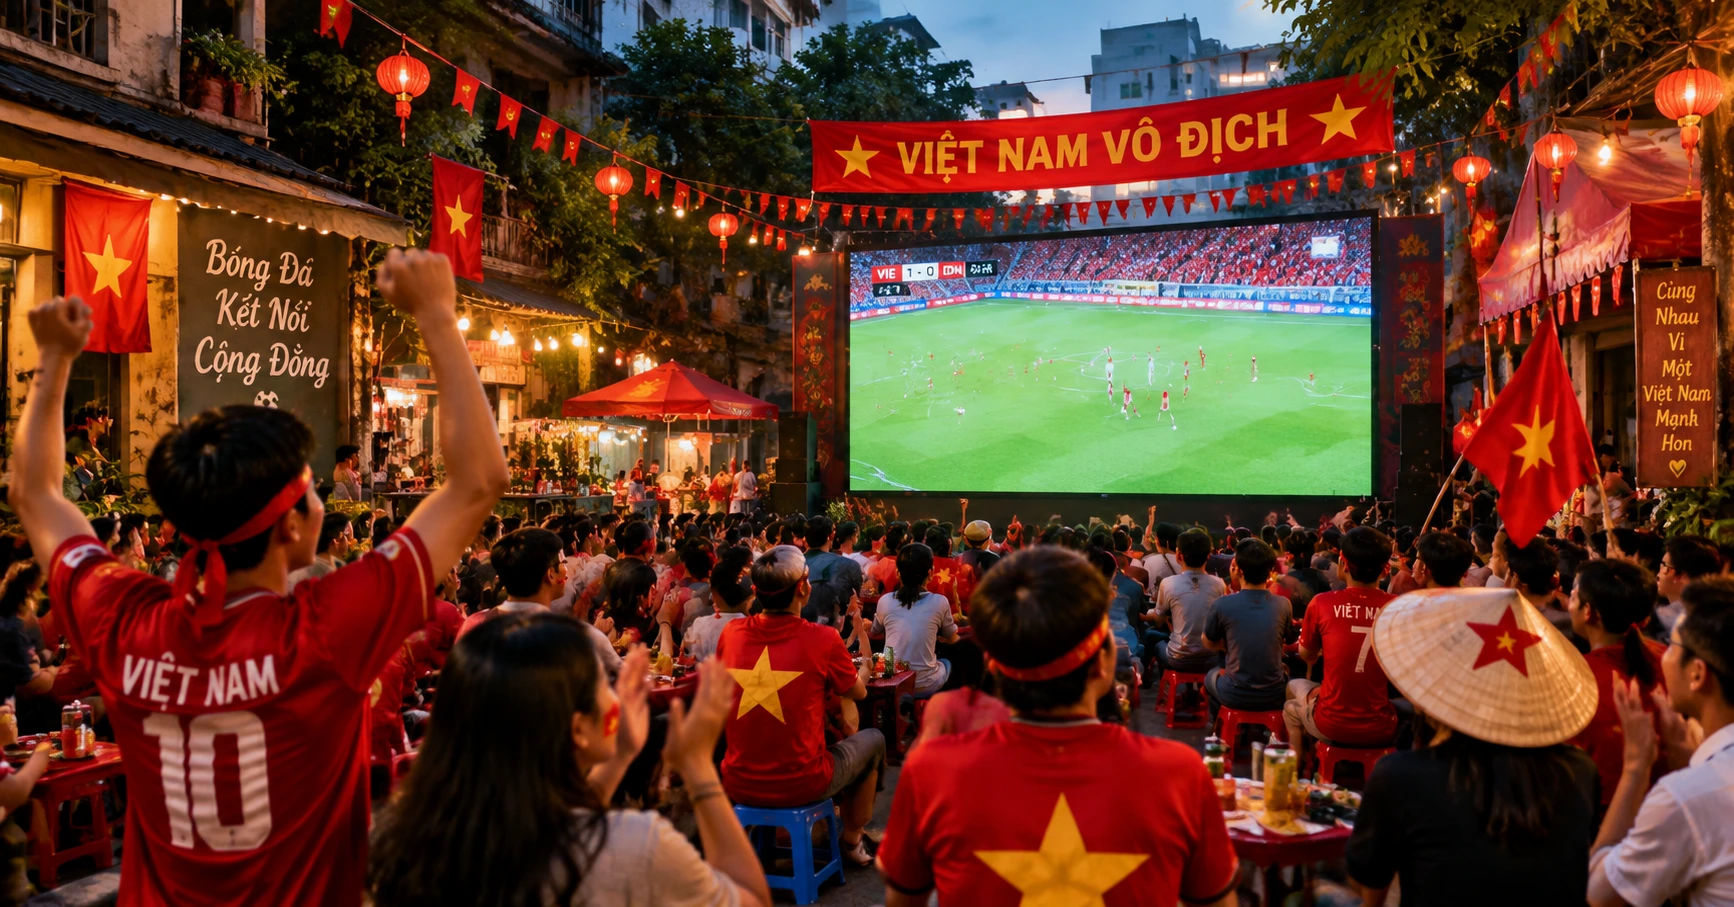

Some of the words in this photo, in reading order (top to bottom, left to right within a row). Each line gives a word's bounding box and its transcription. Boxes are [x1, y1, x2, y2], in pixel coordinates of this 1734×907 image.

[896, 129, 984, 184] VIỆT
[998, 132, 1088, 173] NAM
[1102, 116, 1162, 165] VÔ
[1176, 108, 1289, 164] ĐỊCH
[877, 268, 896, 280] VIE
[906, 268, 912, 278] 1
[926, 266, 935, 277] 0
[1655, 306, 1700, 325] Nhau
[194, 336, 261, 386] Cộng
[1677, 384, 1712, 402] Nam
[1661, 433, 1692, 451] Hon
[1351, 625, 1373, 673] 7
[122, 651, 199, 711] VIỆT
[204, 654, 280, 707] NAM
[142, 710, 272, 852] 10
